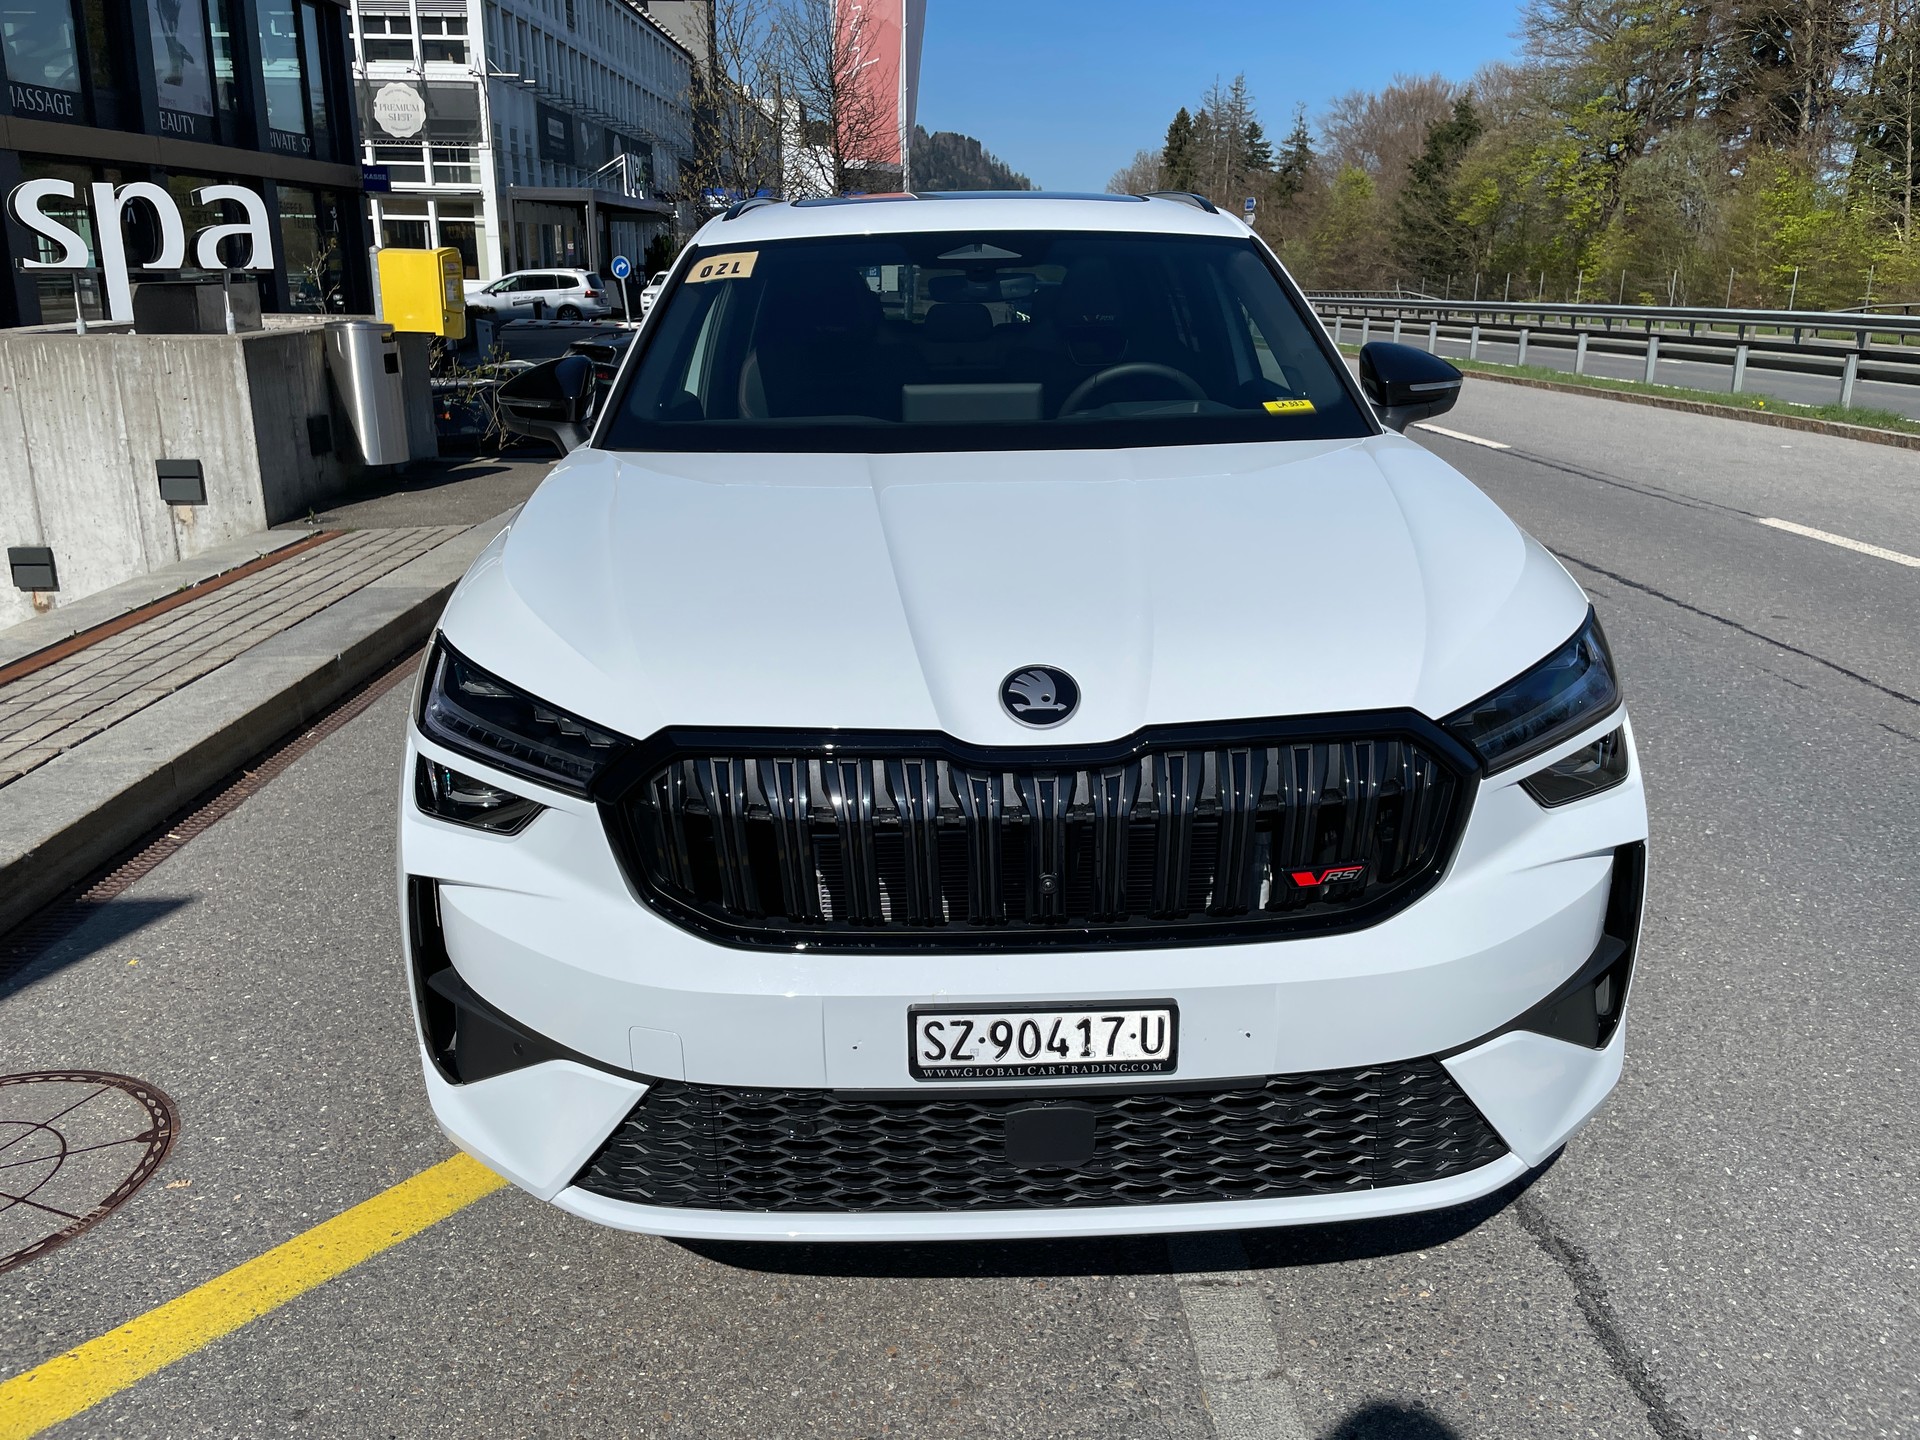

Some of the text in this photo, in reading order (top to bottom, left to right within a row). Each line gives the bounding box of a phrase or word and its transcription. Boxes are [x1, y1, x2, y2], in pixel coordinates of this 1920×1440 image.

[379, 103, 420, 112] PREMIUM
[388, 113, 413, 121] SHOP
[363, 172, 387, 181] KASSE
[12, 178, 275, 321] spa
